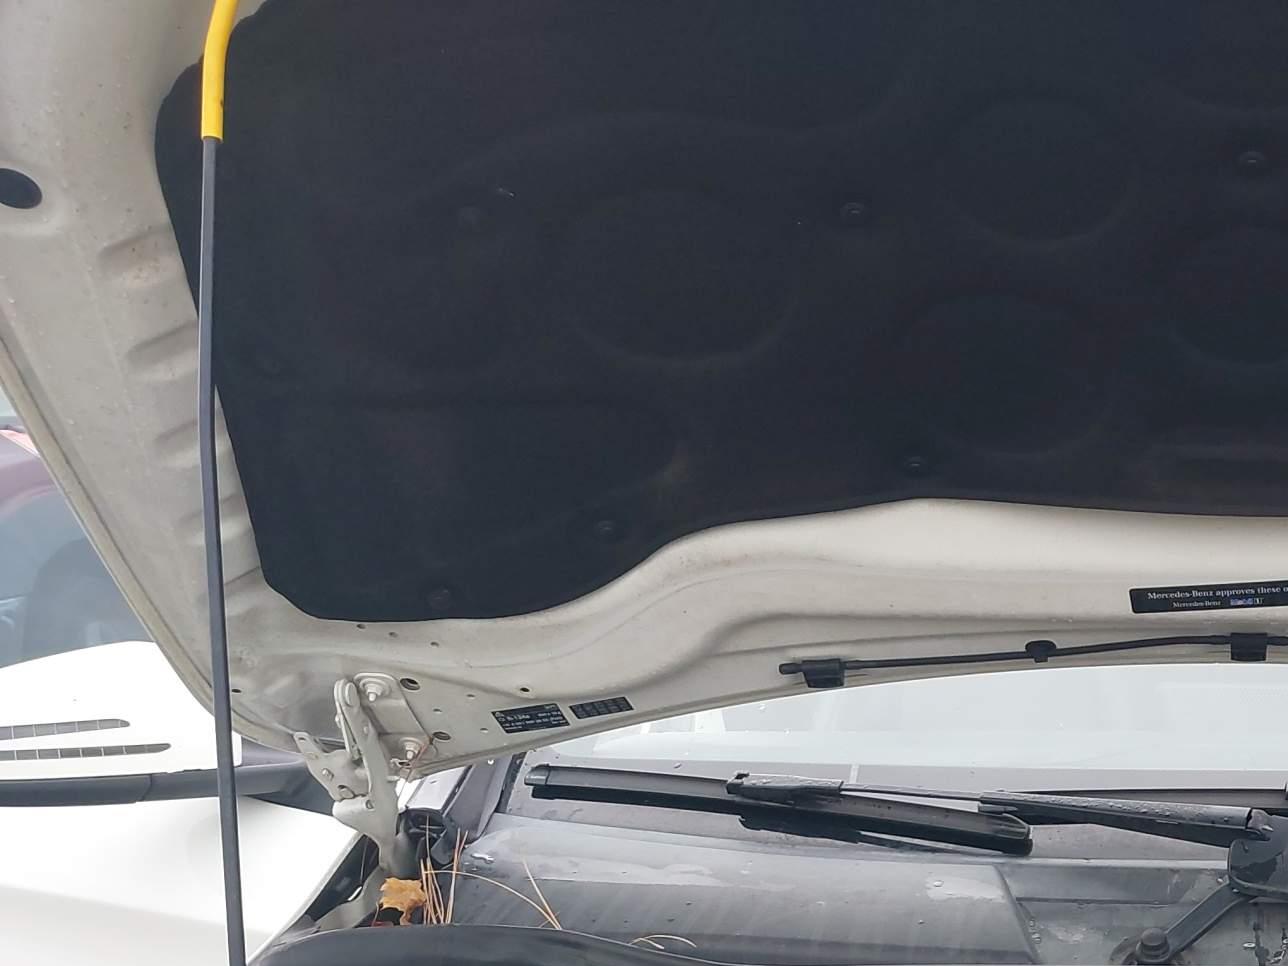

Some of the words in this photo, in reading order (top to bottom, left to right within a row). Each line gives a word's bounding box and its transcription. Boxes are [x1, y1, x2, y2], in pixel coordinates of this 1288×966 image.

[1147, 589, 1214, 600] Mercedes-Benz
[1215, 587, 1256, 598] approves
[1257, 585, 1282, 595] these
[1172, 599, 1221, 608] Mercedes-Benz
